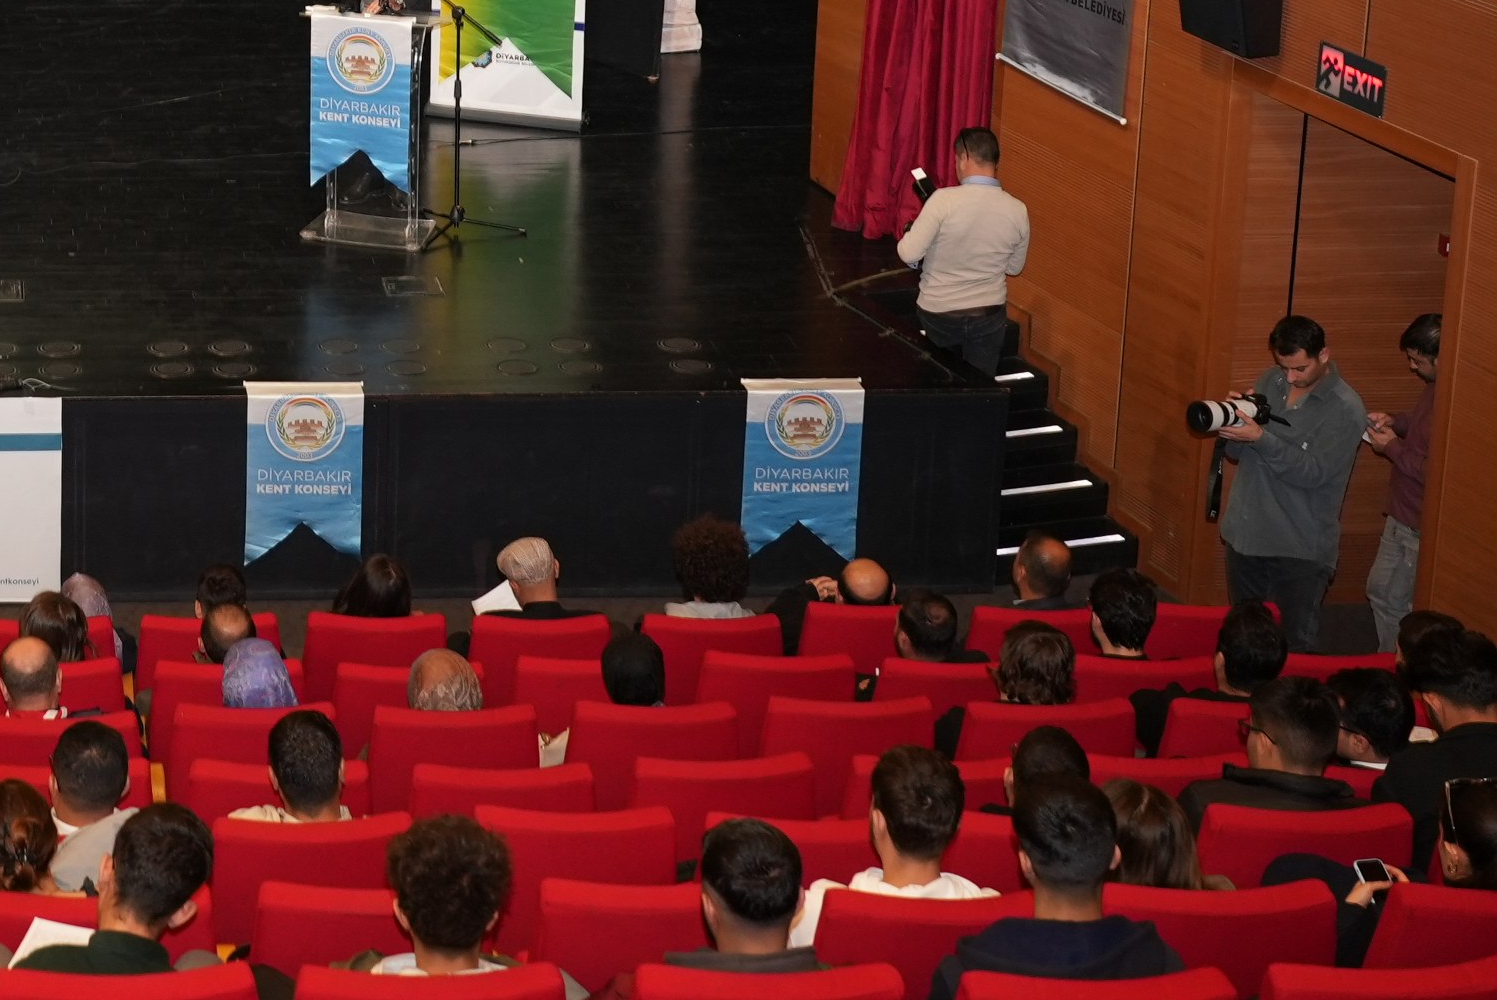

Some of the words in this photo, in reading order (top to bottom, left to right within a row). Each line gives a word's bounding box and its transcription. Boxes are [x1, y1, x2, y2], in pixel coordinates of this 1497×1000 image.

[1344, 64, 1383, 103] EXIT
[320, 97, 400, 116] DİYARBAKIR
[319, 111, 349, 124] KENT
[352, 114, 401, 128] KONSEYİ
[257, 467, 352, 482] DİYARBAKIR
[755, 466, 849, 480] DİYARBAKIR
[256, 483, 291, 494] KENT
[294, 484, 352, 496] KONSEYİ
[753, 481, 789, 492] KENT
[791, 481, 849, 493] KONSEYİ
